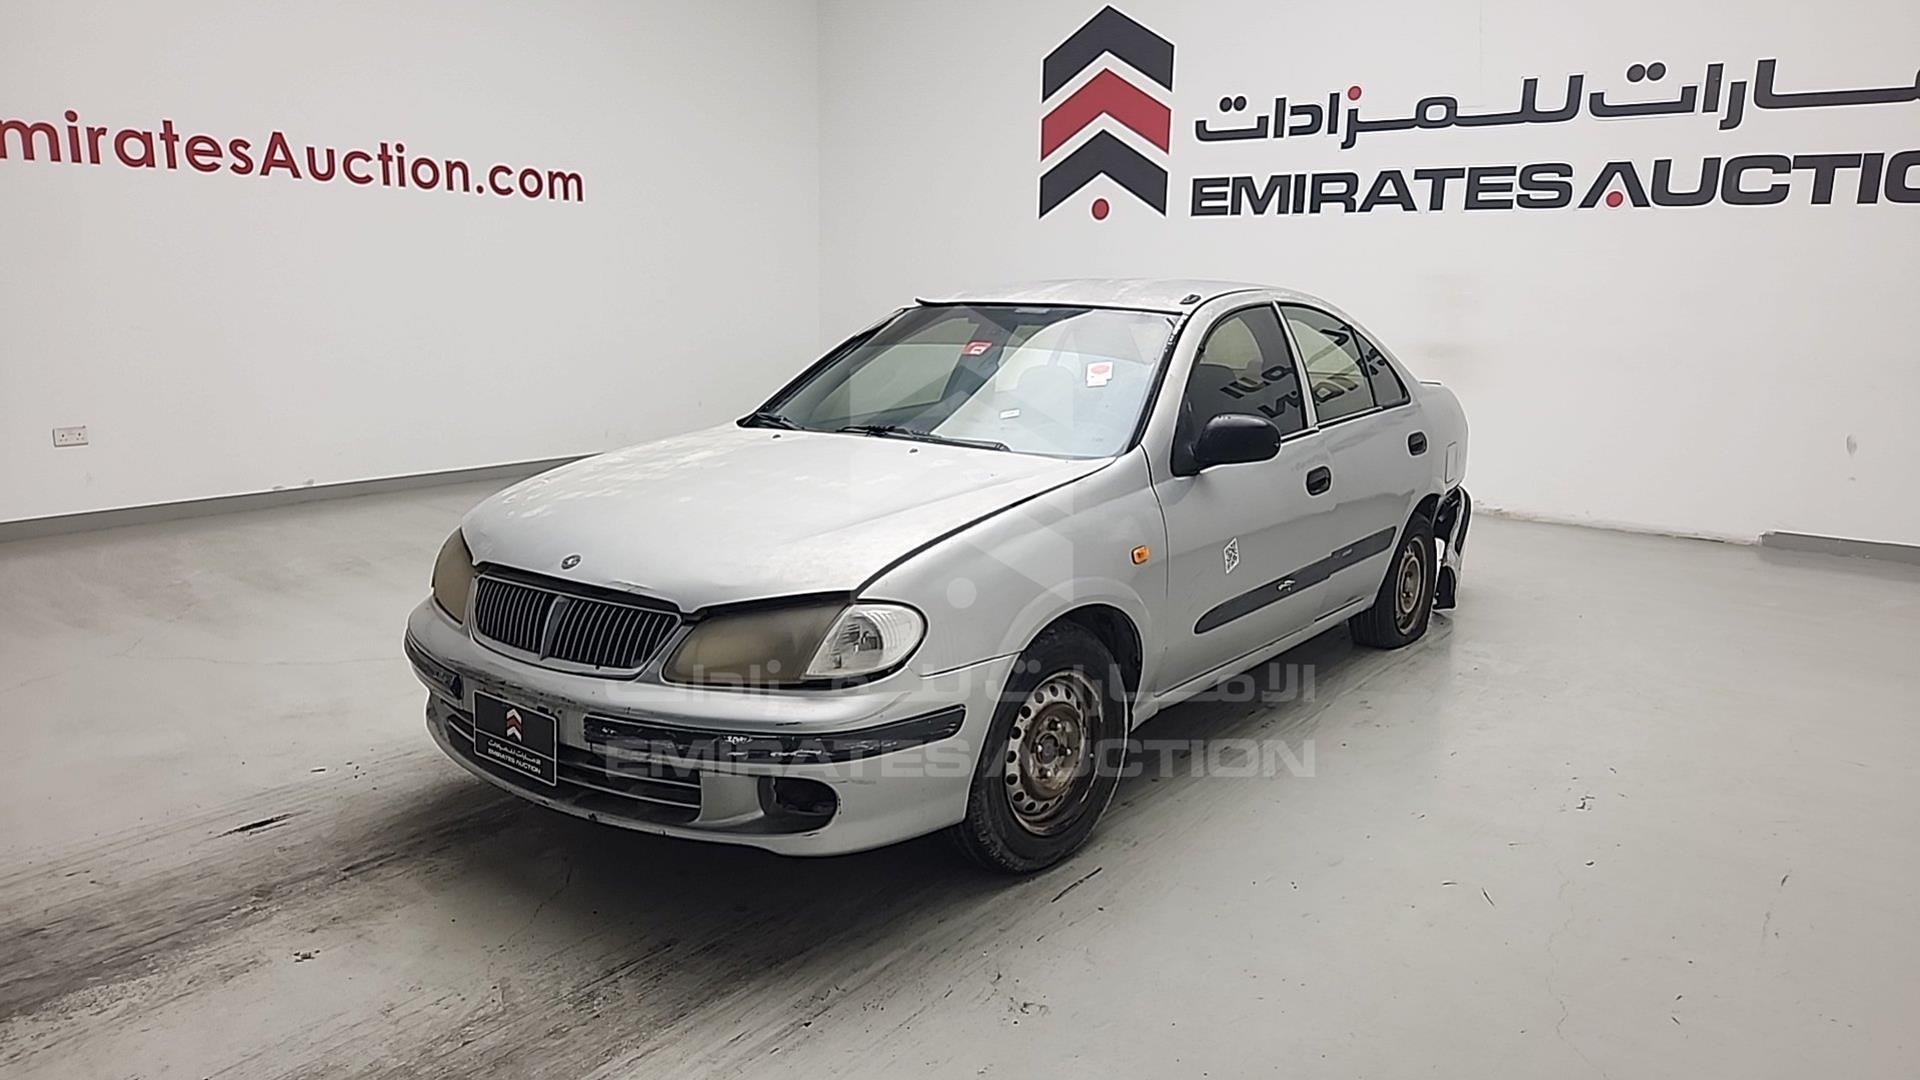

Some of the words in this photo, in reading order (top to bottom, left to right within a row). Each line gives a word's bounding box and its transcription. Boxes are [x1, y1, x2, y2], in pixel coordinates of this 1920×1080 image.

[1195, 74, 1585, 150] للمزادات
[1190, 162, 1574, 217] EMIRATES
[487, 747, 515, 764] EMIRATES
[515, 759, 541, 775] AUCTION
